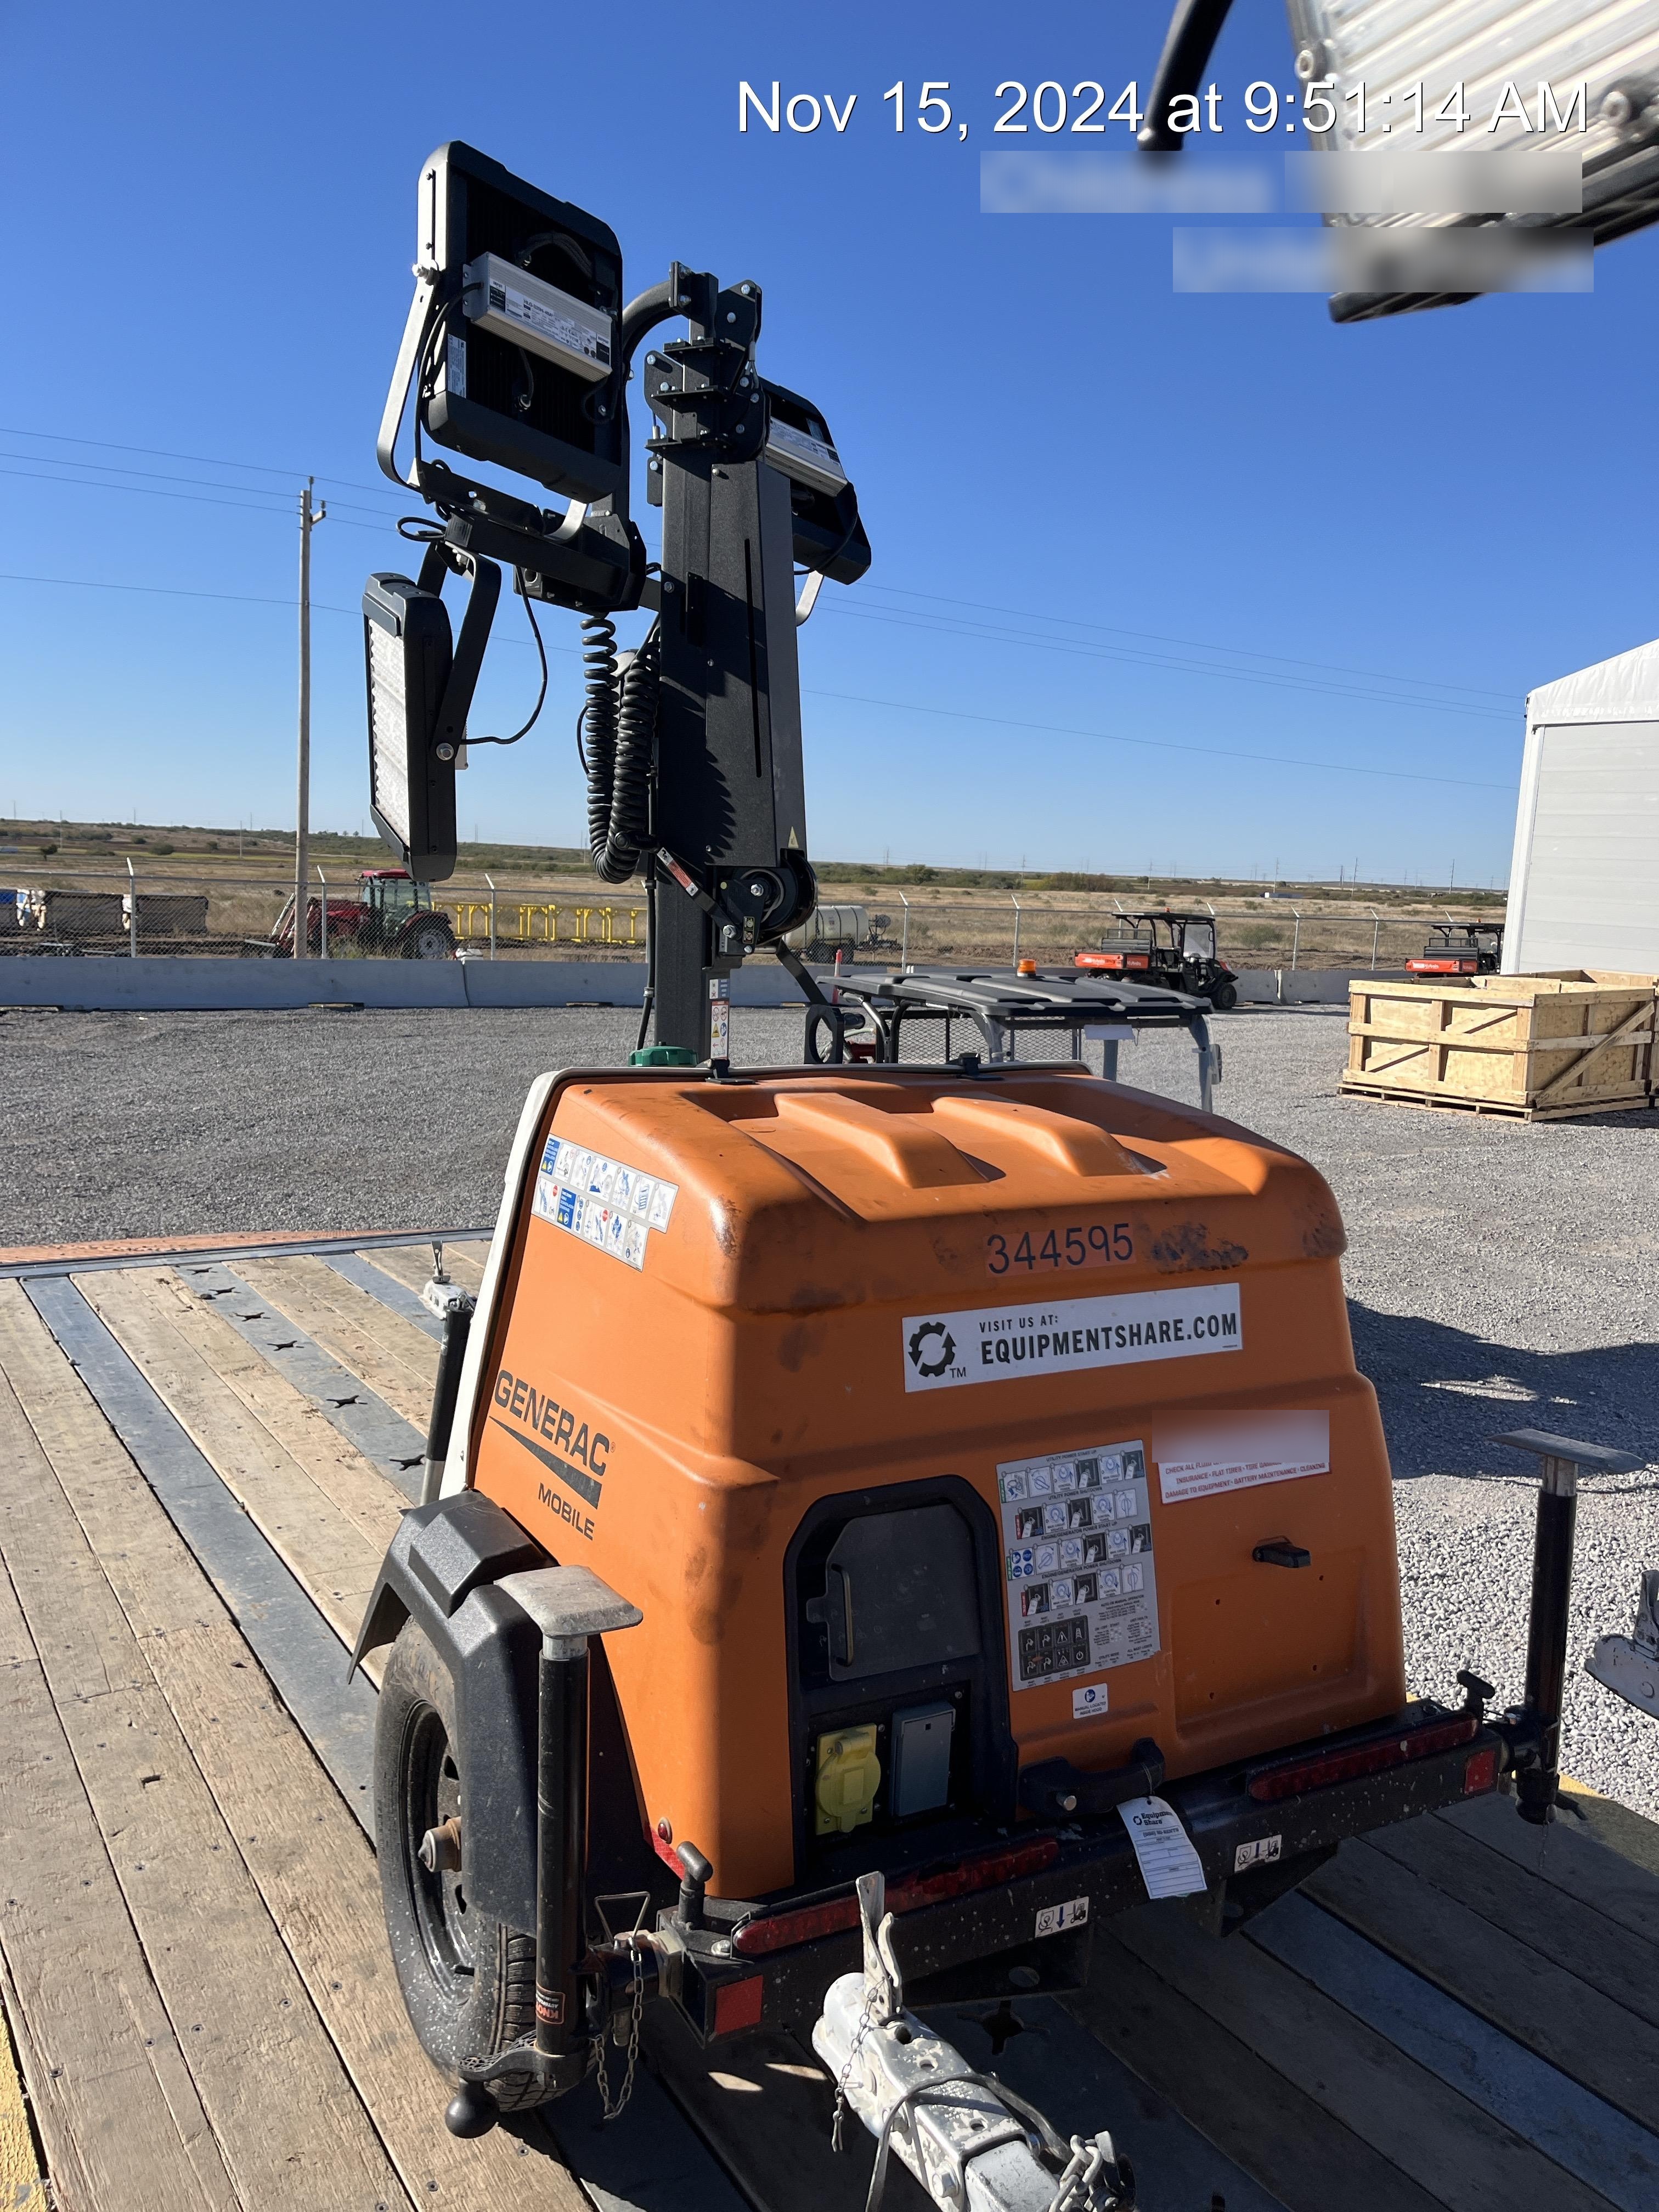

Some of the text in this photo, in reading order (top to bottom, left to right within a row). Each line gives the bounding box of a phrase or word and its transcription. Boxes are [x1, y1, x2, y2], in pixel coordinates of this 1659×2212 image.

[988, 1223, 1132, 1274] 344595
[979, 1314, 1058, 1333] VISIT US AT:
[981, 1313, 1237, 1365] EQUIPMENTSHARE.COM
[950, 1367, 967, 1379] TM
[494, 1370, 610, 1476] GENERAC
[1165, 1466, 1184, 1475] CHECK
[1165, 1488, 1188, 1498] DAMAGE
[1198, 1481, 1230, 1492] EQUIPMENT
[1234, 1475, 1257, 1485] BATTERY
[1259, 1468, 1296, 1480] MAINTENANCE
[1300, 1463, 1325, 1472] CLEANING
[1176, 1473, 1207, 1484] INSURANCE
[1079, 1486, 1102, 1494] SHUTDOWN
[538, 1482, 595, 1541] MOBILE
